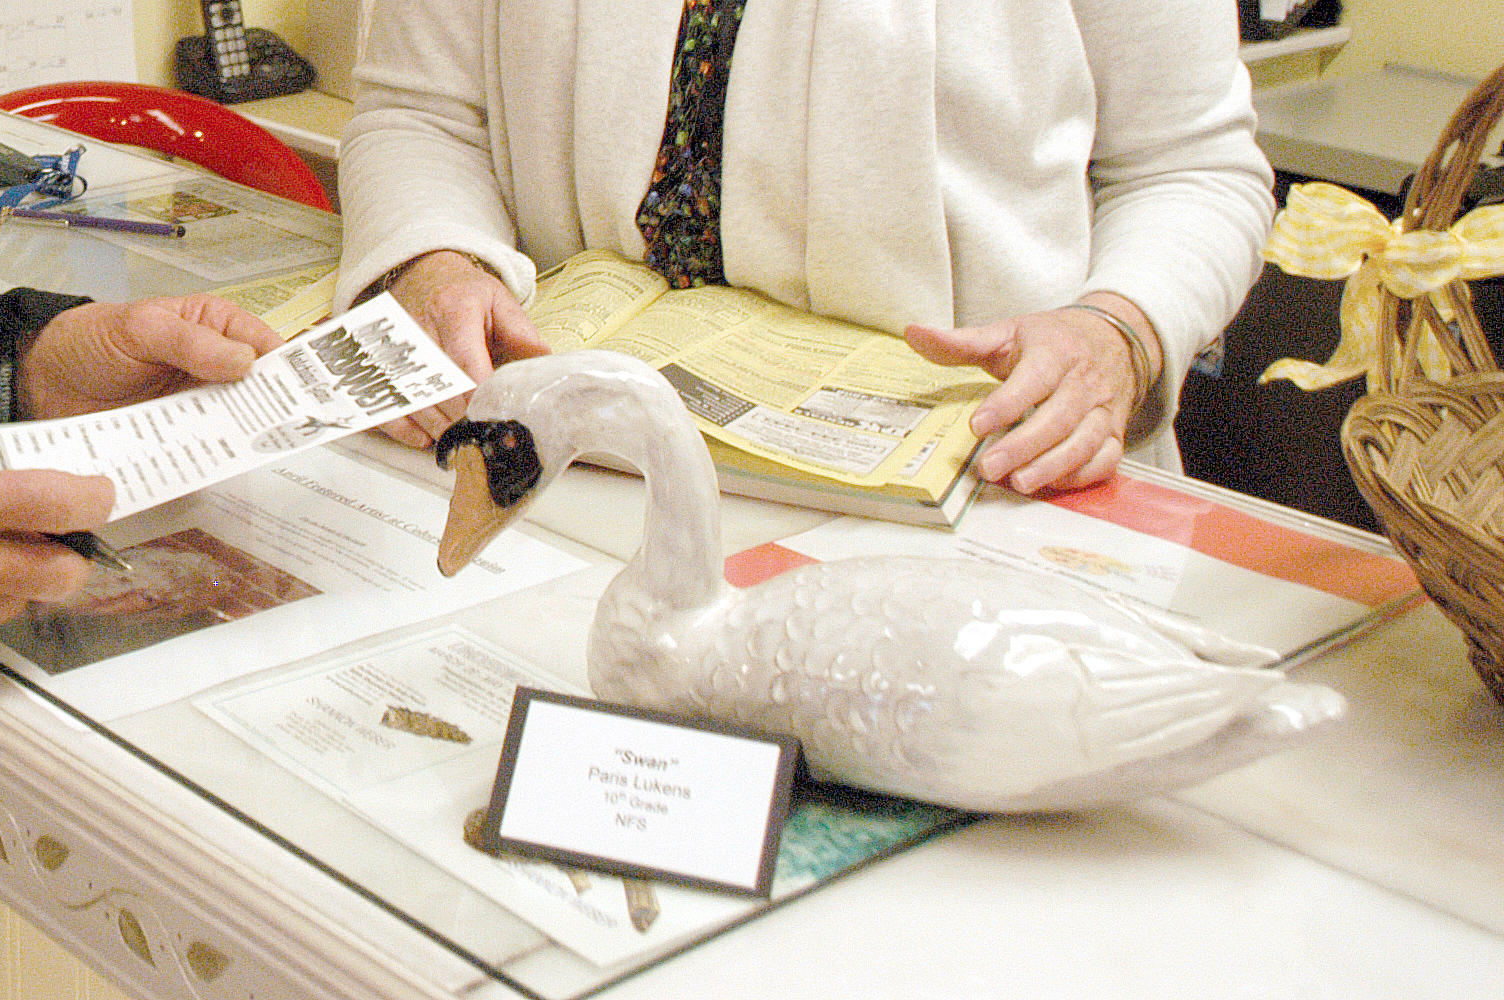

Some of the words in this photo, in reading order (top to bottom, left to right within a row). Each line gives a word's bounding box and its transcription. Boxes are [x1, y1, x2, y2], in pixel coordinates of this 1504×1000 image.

[358, 502, 388, 521] Artist
[615, 748, 679, 771] "Swan"
[589, 766, 628, 787] Paris
[633, 774, 691, 800] Lukens
[629, 795, 668, 815] Grade
[615, 811, 647, 831] NFS
